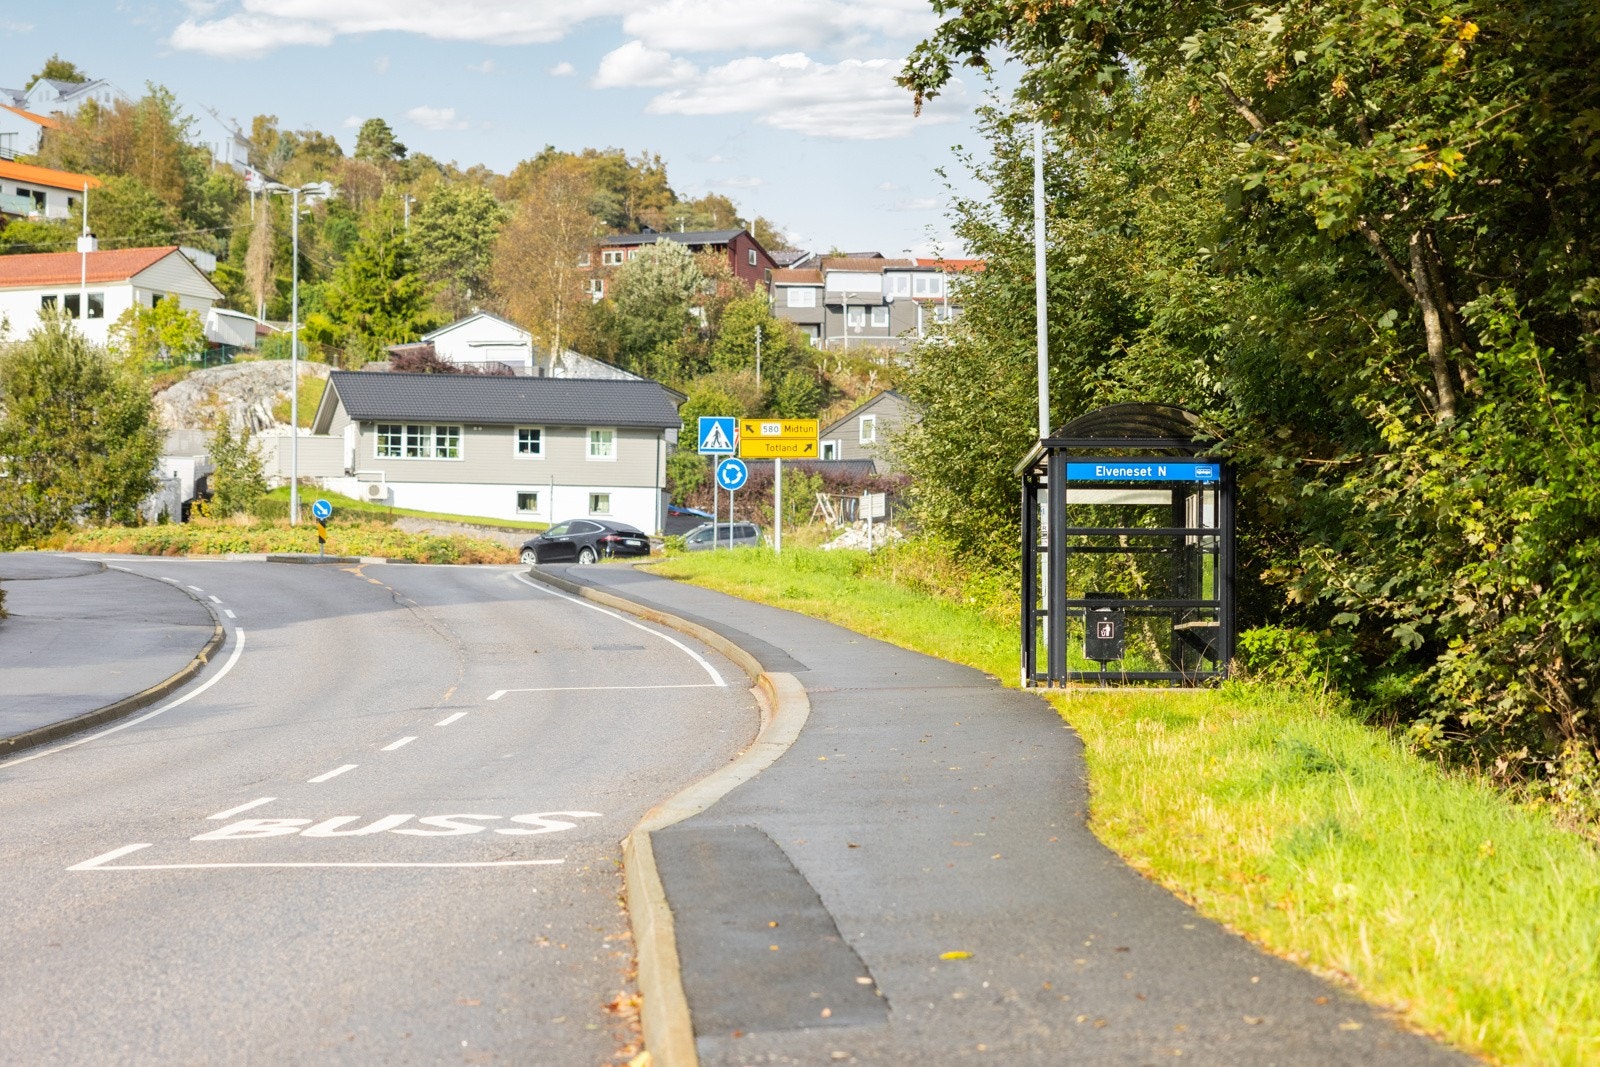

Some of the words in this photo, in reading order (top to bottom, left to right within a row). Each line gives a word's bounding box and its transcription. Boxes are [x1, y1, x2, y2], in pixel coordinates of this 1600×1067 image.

[766, 444, 798, 452] Totland
[1096, 466, 1152, 476] Elveneset
[1158, 466, 1167, 476] N
[189, 810, 603, 842] BUSS
